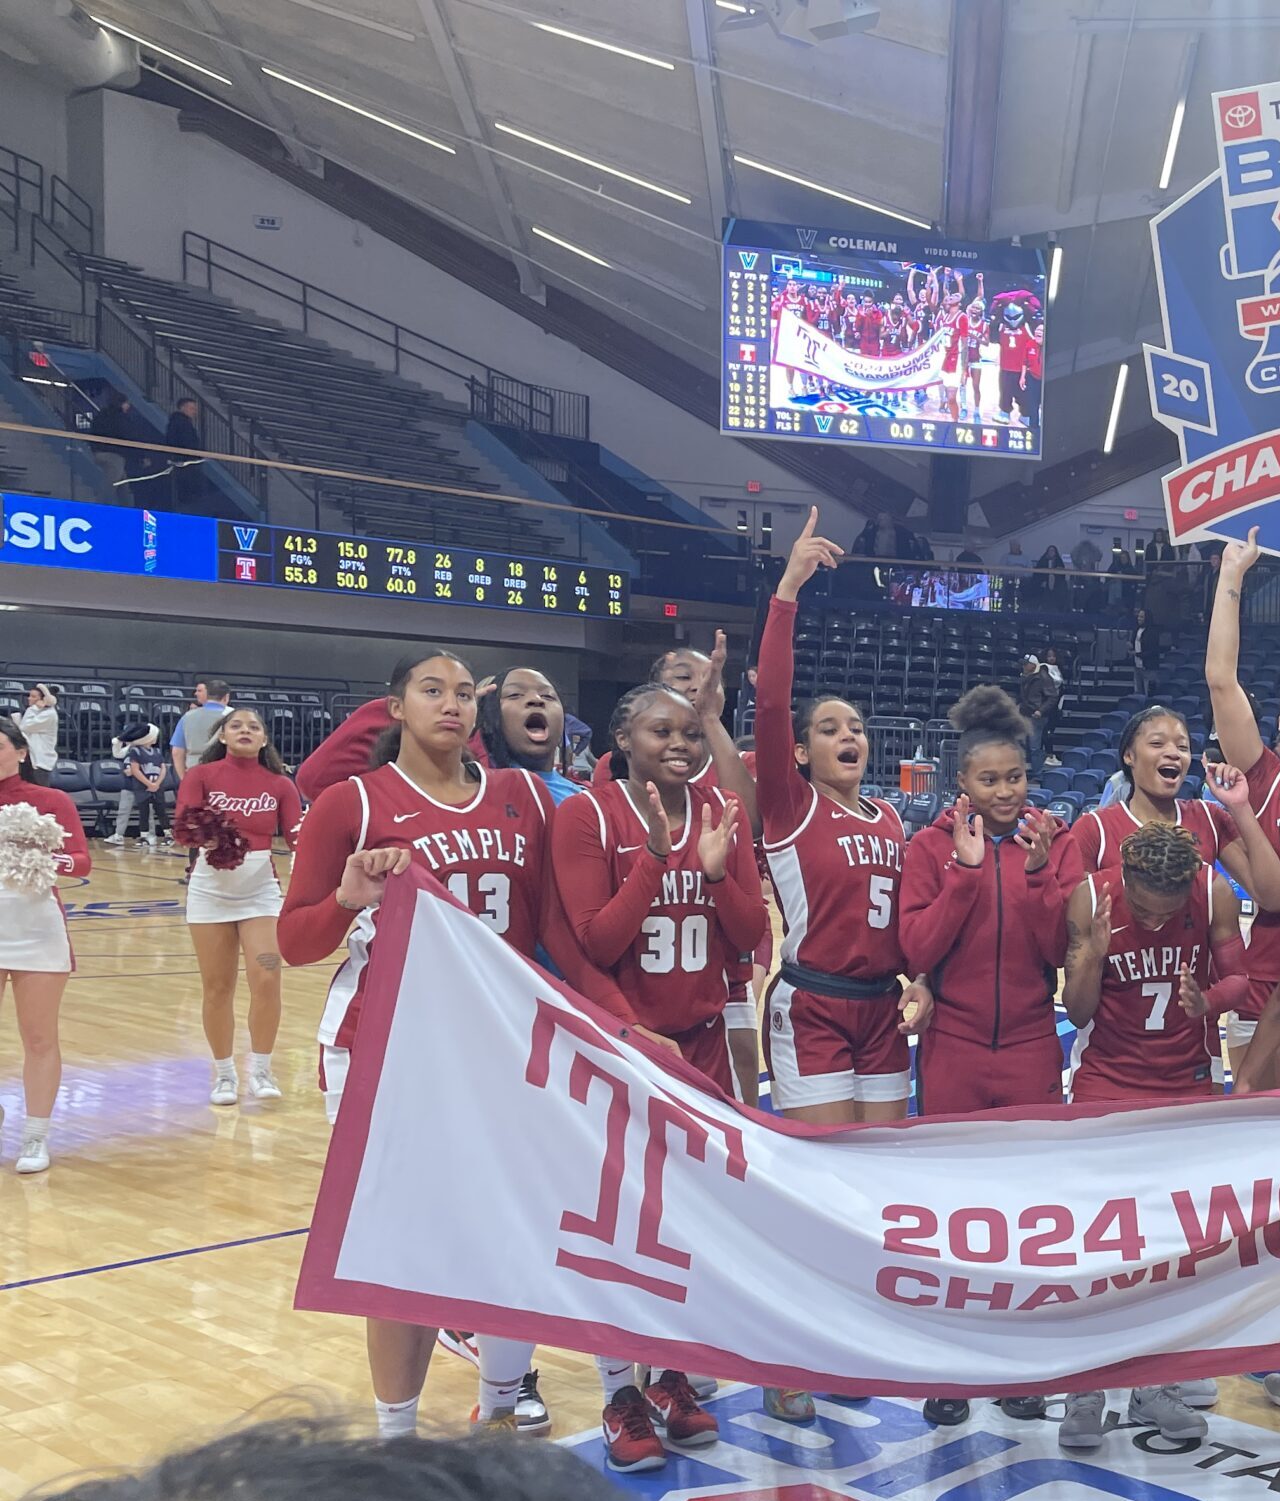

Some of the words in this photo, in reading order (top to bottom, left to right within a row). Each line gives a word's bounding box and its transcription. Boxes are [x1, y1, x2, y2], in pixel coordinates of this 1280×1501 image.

[828, 236, 897, 254] COLEMAN
[924, 247, 949, 257] VIDEO
[951, 249, 978, 260] BOARD
[747, 282, 754, 290] 2
[761, 283, 766, 291] 1
[745, 316, 755, 326] 11
[761, 318, 766, 326] 1
[745, 328, 756, 337] 12
[761, 329, 766, 338] 1
[729, 394, 739, 403] 11
[1161, 373, 1198, 402] 20
[776, 412, 791, 420] TOL
[776, 422, 791, 431] FLS
[840, 420, 858, 434] 62
[890, 423, 913, 438] 0.0
[956, 428, 974, 444] 76
[4, 511, 93, 553] SIC
[284, 535, 317, 553] 41.3
[337, 541, 368, 559] 15.0
[386, 547, 416, 565] 77.8
[434, 553, 452, 569] 26
[475, 558, 484, 572] 8
[508, 562, 523, 577] 18
[543, 566, 557, 581] 16
[578, 570, 587, 585] 6
[608, 574, 621, 589] 13
[290, 554, 312, 565] FG%
[339, 559, 365, 571] 3PT%
[391, 565, 412, 576] FT%
[434, 570, 453, 581] REB
[468, 574, 492, 585] OREB
[504, 578, 527, 590] DREB
[541, 582, 557, 592] AST
[574, 586, 590, 596] STL
[609, 590, 620, 599] TO
[284, 566, 318, 584] 55.8
[336, 572, 368, 589] 50.0
[386, 577, 416, 594] 60.0
[434, 583, 452, 598] 34
[475, 586, 484, 601] 8
[507, 590, 523, 605] 26
[543, 593, 557, 608] 13
[578, 598, 587, 612] 4
[608, 601, 622, 616] 15
[208, 791, 278, 817] Temple
[413, 828, 527, 870] TEMPLE
[837, 835, 901, 872] TEMPL
[447, 873, 510, 934] 13
[868, 874, 893, 929] 5
[640, 915, 708, 973] 30
[1109, 944, 1200, 982] TEMPLE
[1141, 982, 1172, 1030] 7
[882, 1197, 1146, 1267] 2024
